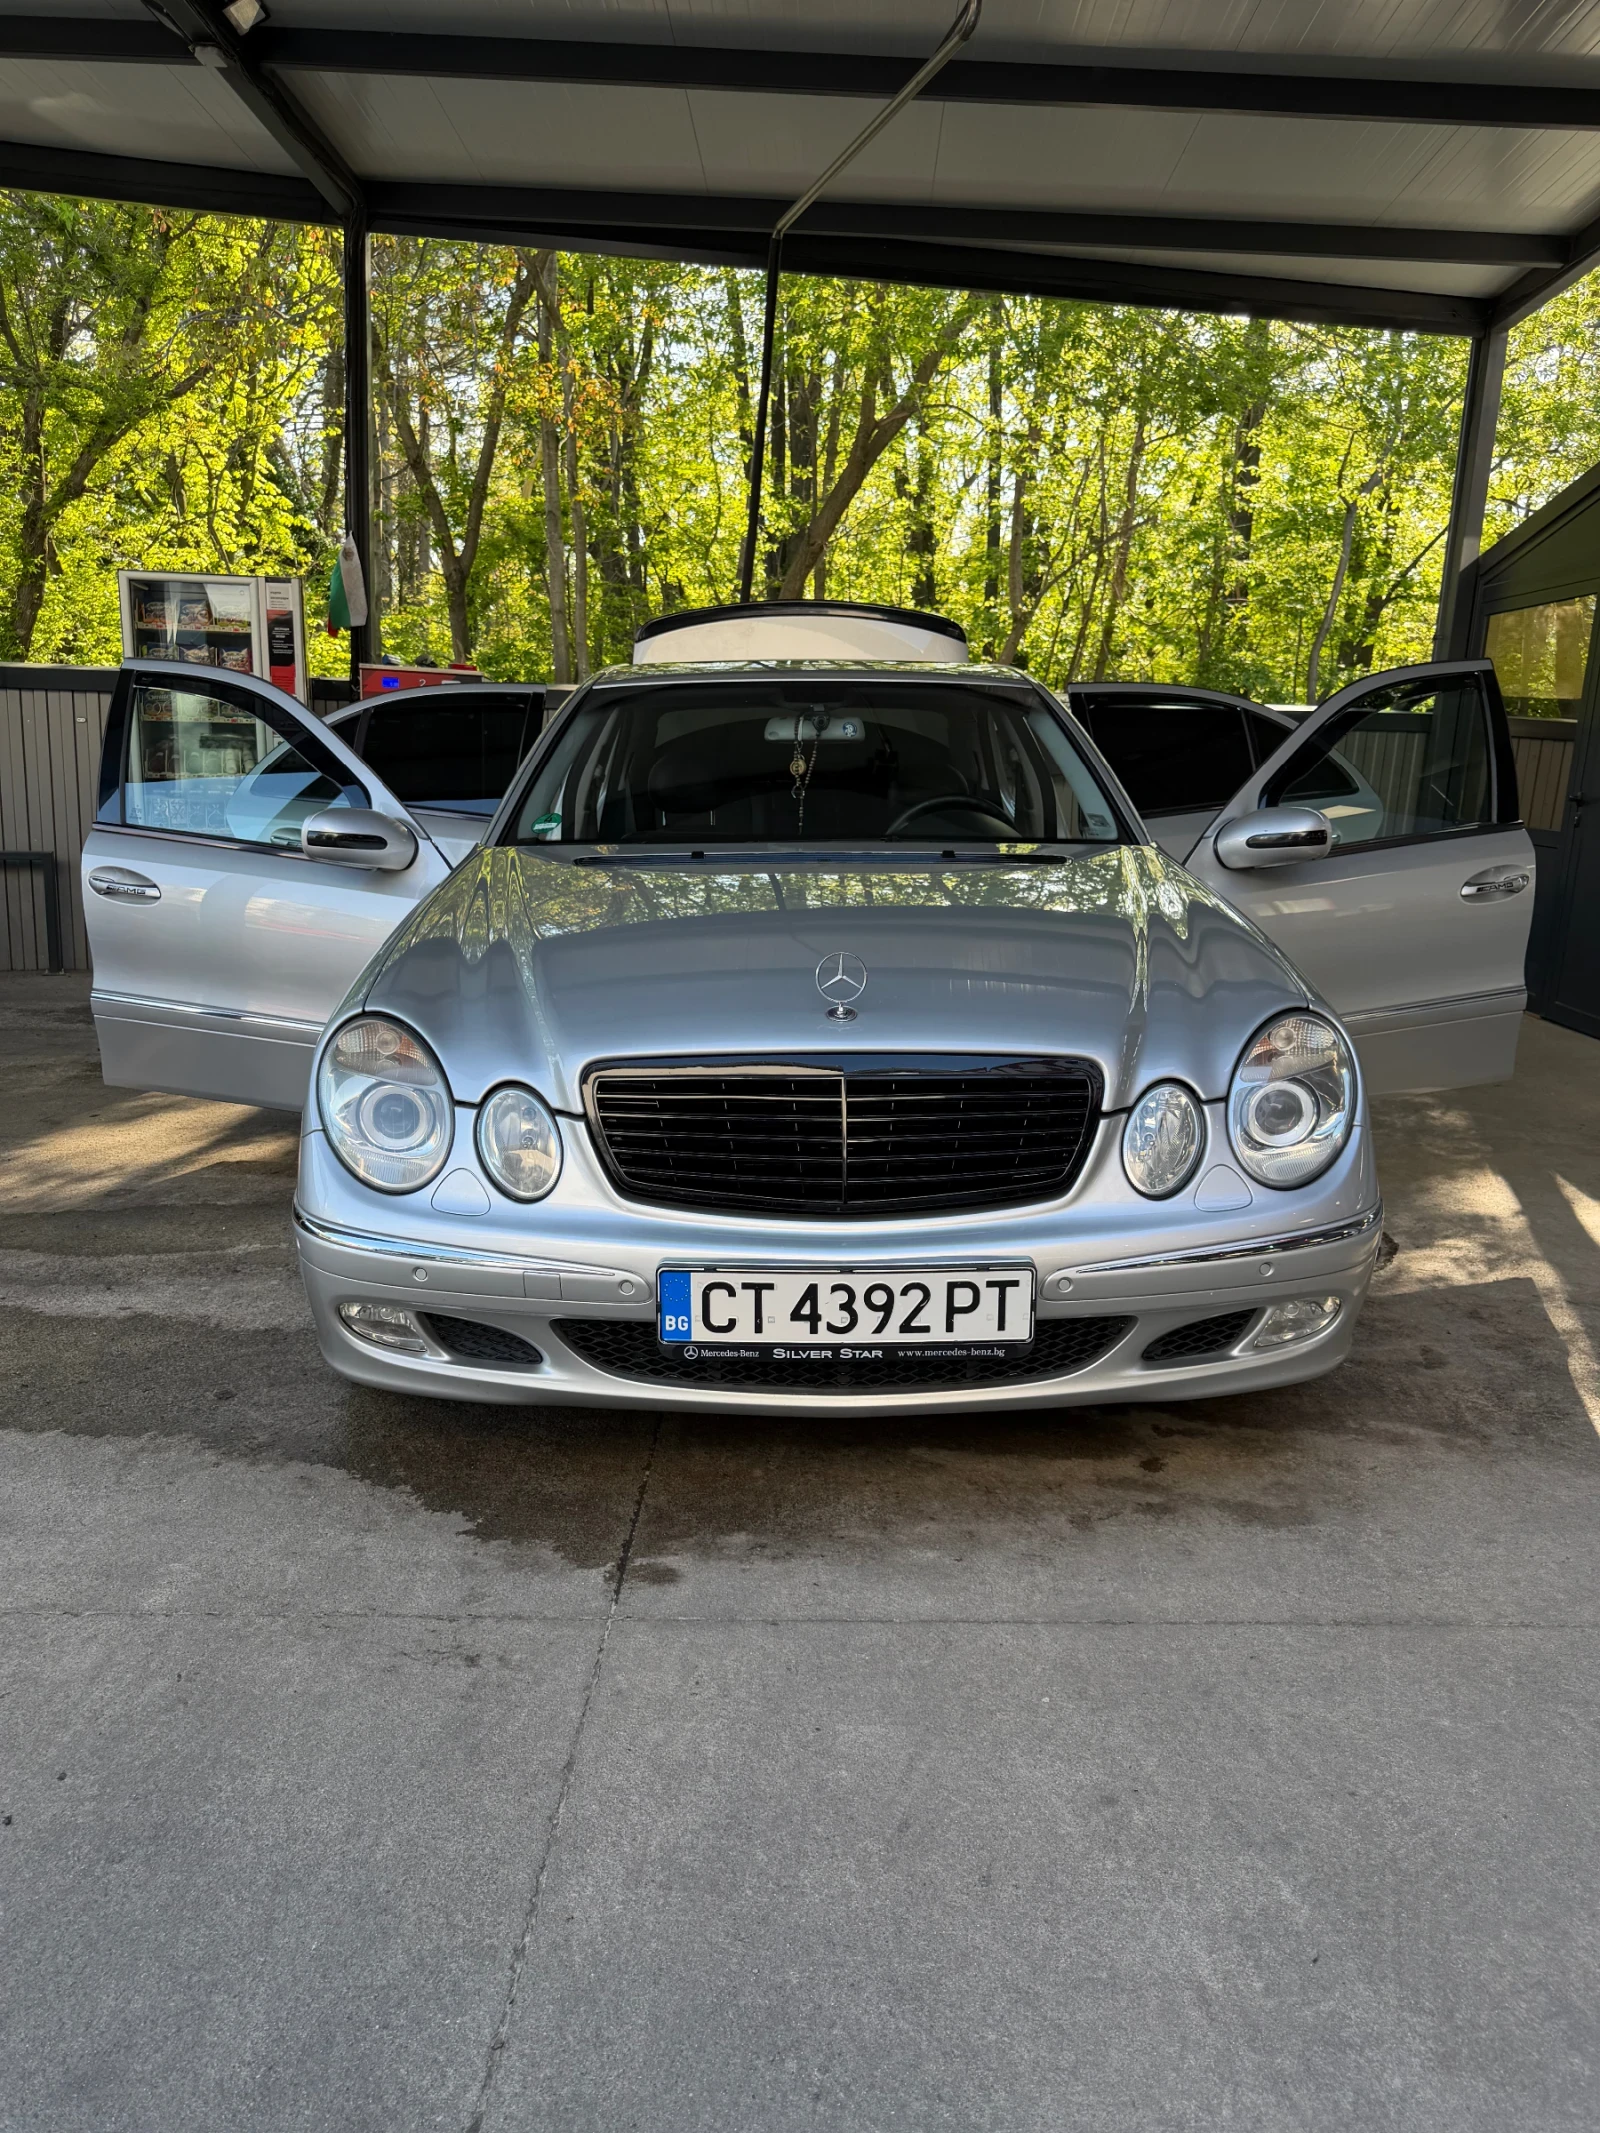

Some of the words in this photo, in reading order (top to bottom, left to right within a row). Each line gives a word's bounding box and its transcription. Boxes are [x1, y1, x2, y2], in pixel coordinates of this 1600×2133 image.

[115, 885, 147, 895] AMG
[701, 1281, 775, 1334] CT
[789, 1282, 931, 1335] 4392
[945, 1279, 1020, 1333] PT
[665, 1315, 689, 1331] BG
[700, 1349, 760, 1358] Mercedes-Benz
[772, 1347, 833, 1359] SILVER
[839, 1347, 883, 1359] STAR
[897, 1347, 1006, 1358] www.mercedes-benz.bg
